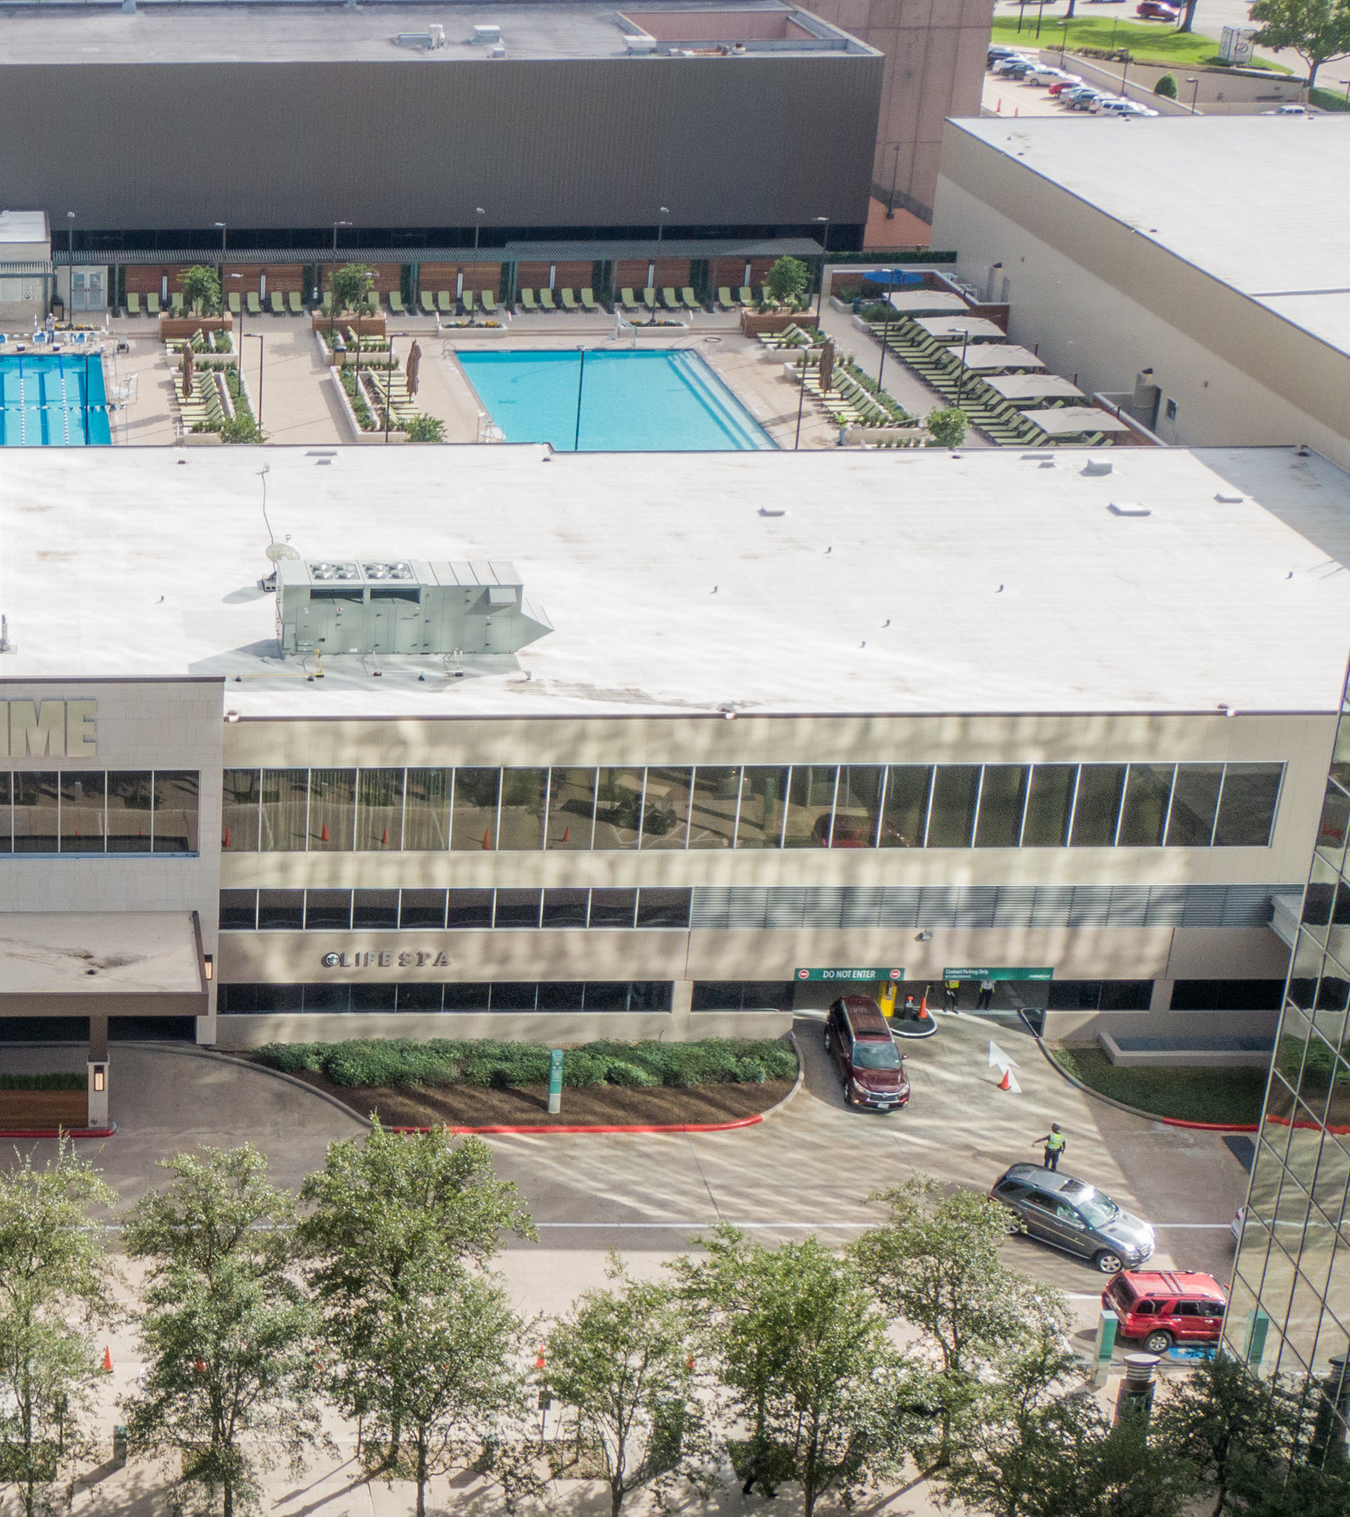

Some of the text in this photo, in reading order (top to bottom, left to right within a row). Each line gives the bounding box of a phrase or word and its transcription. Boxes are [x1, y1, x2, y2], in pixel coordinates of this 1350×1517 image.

[340, 951, 450, 967] LIFE SPA
[822, 970, 876, 978] DO NOT ENTER
